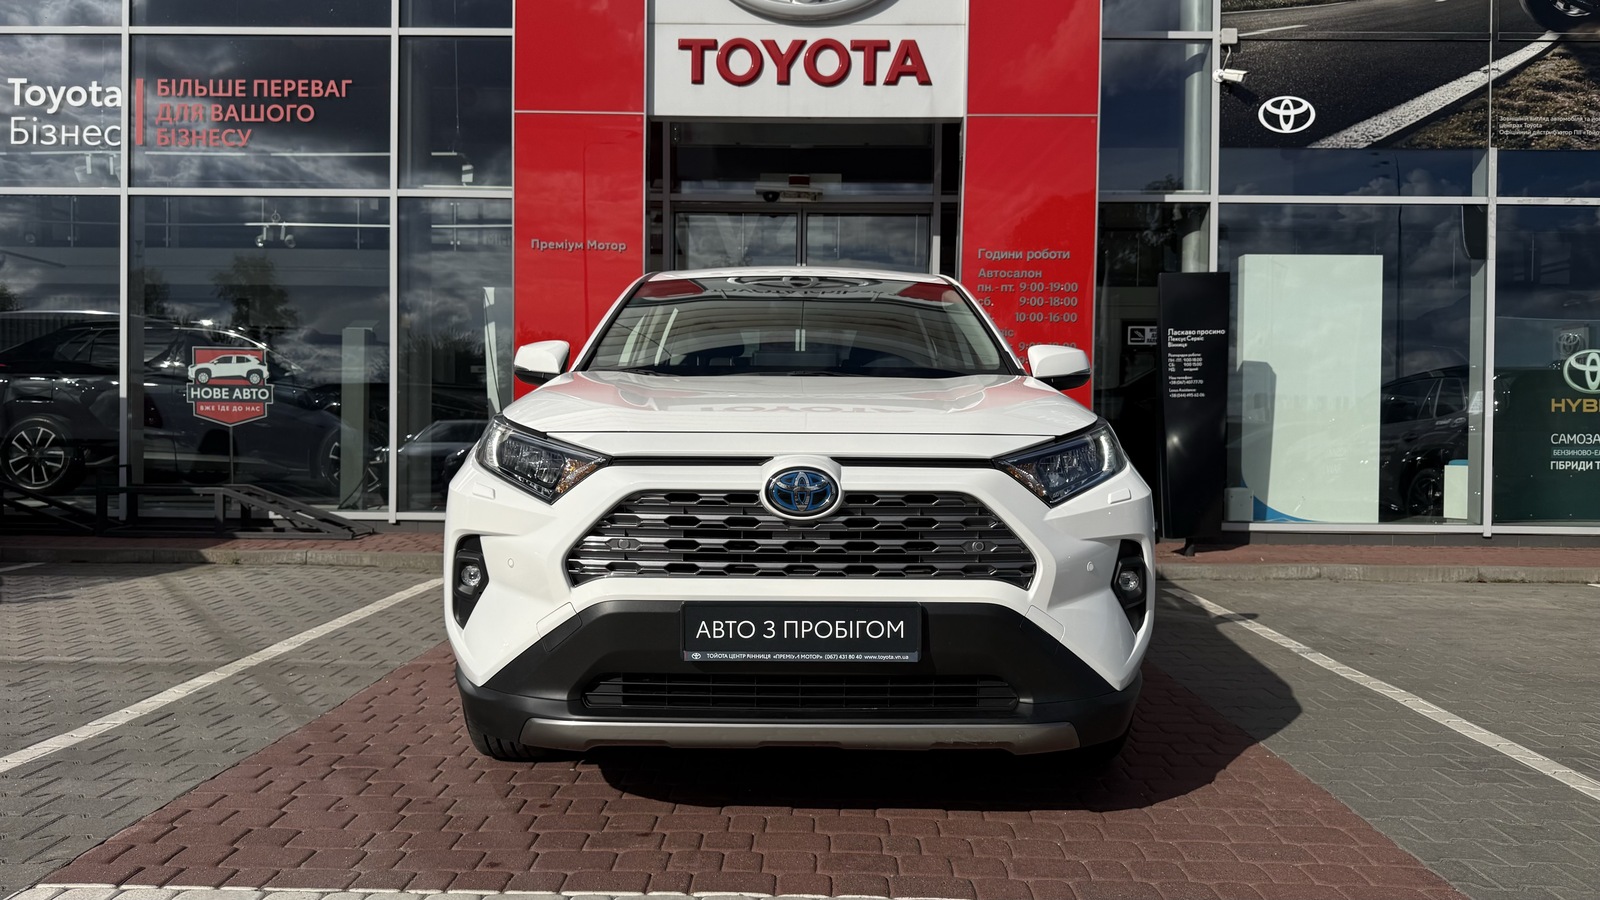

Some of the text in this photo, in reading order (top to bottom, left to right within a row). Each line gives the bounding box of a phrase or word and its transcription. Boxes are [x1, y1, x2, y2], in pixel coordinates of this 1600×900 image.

[678, 38, 932, 87] TOYOTA
[8, 78, 121, 114] Toyota
[157, 79, 352, 97] БІЛЬШЕ ПЕРЕВАГ
[155, 103, 315, 124] ДЛЯ ВАШОГО
[10, 116, 121, 146] Бізнес
[156, 128, 252, 147] БІЗНЕСУ
[531, 239, 627, 252] Преміум Мотор
[978, 248, 1070, 261] Години роботи
[978, 268, 1042, 278] Автосалон
[1015, 312, 1078, 322] 10:00-16:00
[191, 387, 269, 400] НОВЕ АВТО
[1551, 398, 1600, 413] HYB
[1550, 461, 1593, 471] ГІБРИДИ
[696, 620, 904, 639] АВТО З ПРОБІГОМ
